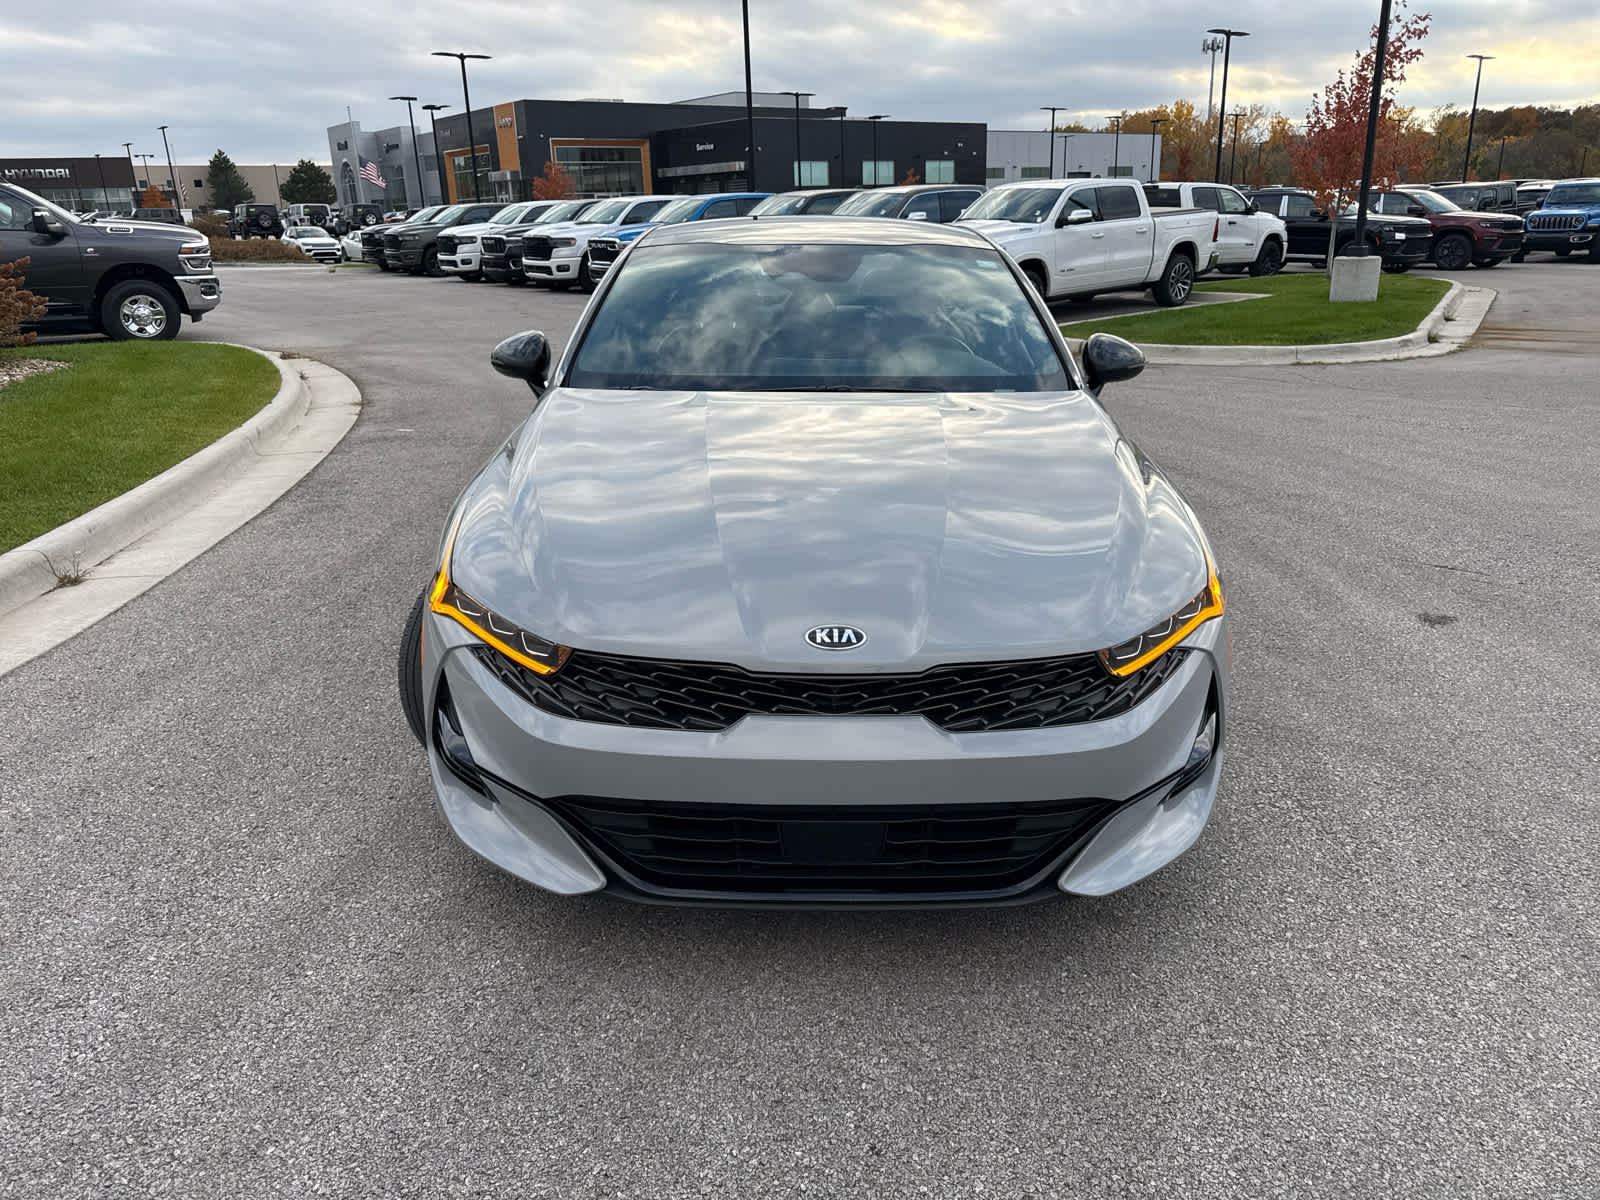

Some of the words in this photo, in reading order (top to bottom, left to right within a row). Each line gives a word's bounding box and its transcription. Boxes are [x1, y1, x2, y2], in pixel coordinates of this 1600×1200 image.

[695, 143, 714, 152] Service
[4, 168, 70, 179] HYUNDAI
[815, 628, 857, 643] KIA
